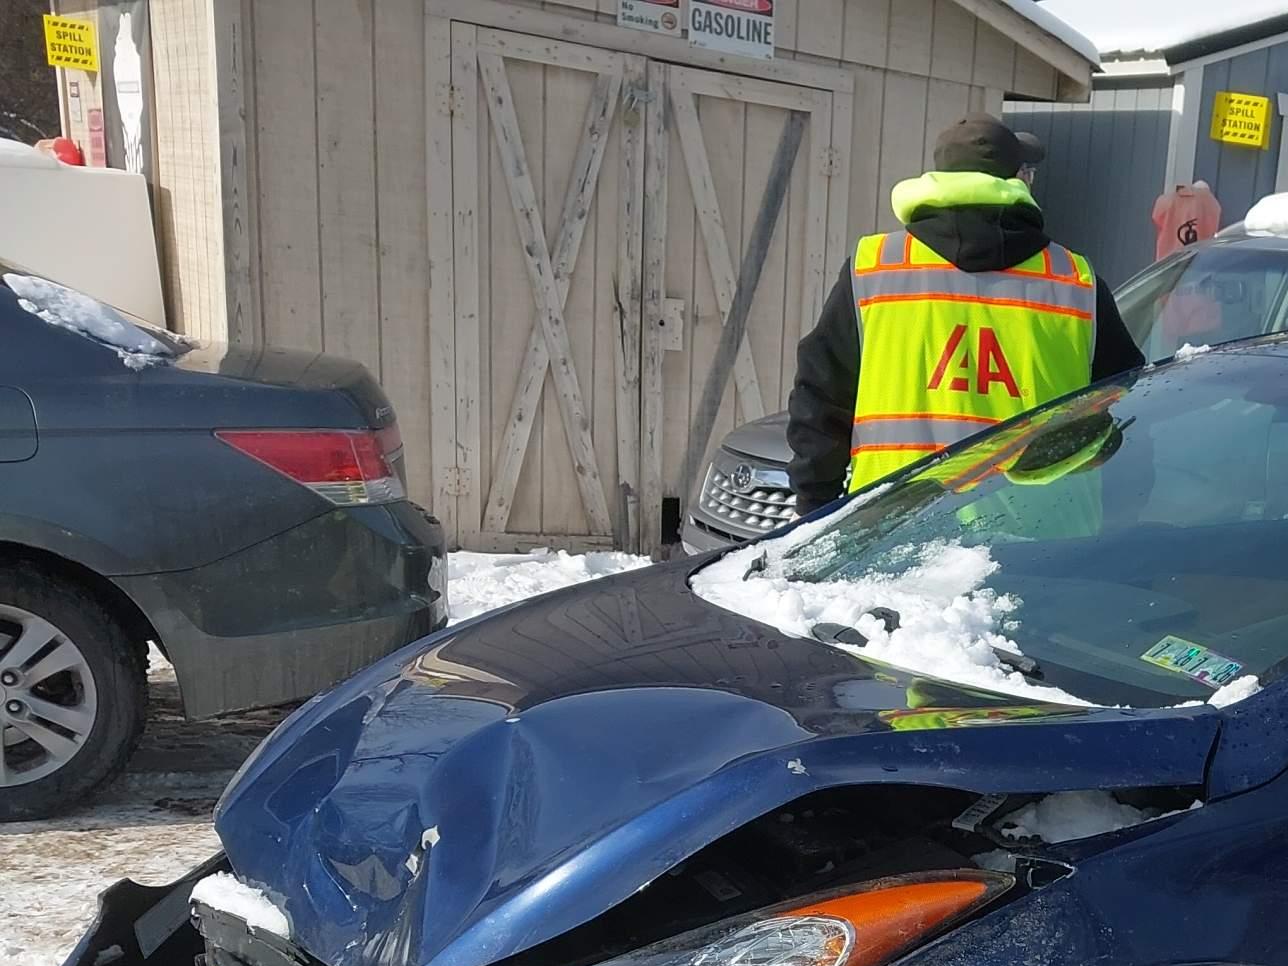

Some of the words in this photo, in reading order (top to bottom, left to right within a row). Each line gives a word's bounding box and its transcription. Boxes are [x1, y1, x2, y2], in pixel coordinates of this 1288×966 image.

[622, 1, 634, 11] No
[622, 12, 659, 29] Smoking
[691, 7, 773, 46] GASOLINE
[55, 30, 84, 43] SPILL
[50, 42, 92, 57] STATION
[1229, 107, 1255, 118] SPILL
[1221, 118, 1261, 132] STATION
